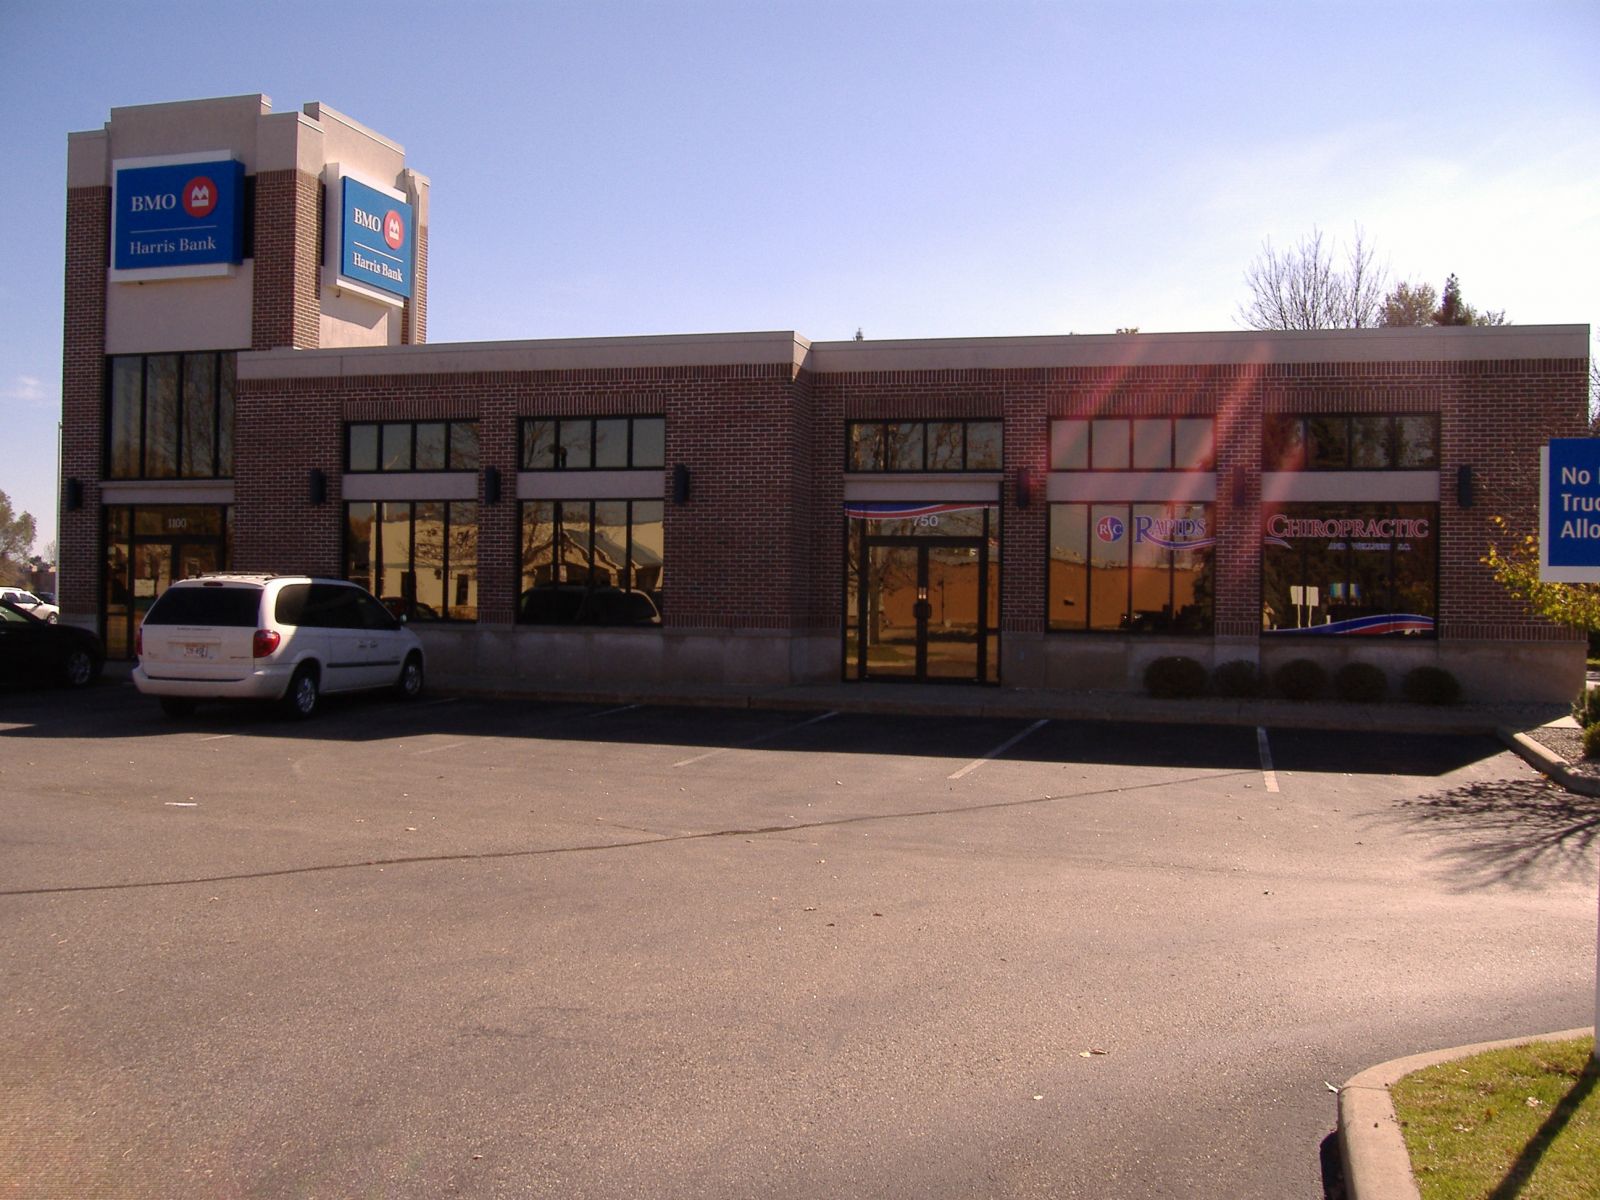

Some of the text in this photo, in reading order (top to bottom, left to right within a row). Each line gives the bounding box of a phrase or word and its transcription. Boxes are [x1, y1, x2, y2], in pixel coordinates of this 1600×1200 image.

[131, 193, 177, 212] BMO
[354, 207, 381, 232] BMO
[129, 235, 217, 255] Harris Bank
[353, 252, 404, 282] Harris Bank
[1561, 466, 1591, 486] No
[912, 515, 939, 527] 750
[1135, 514, 1429, 543] RAPIDS CHIROPRACTIC
[1560, 518, 1600, 539] Allo
